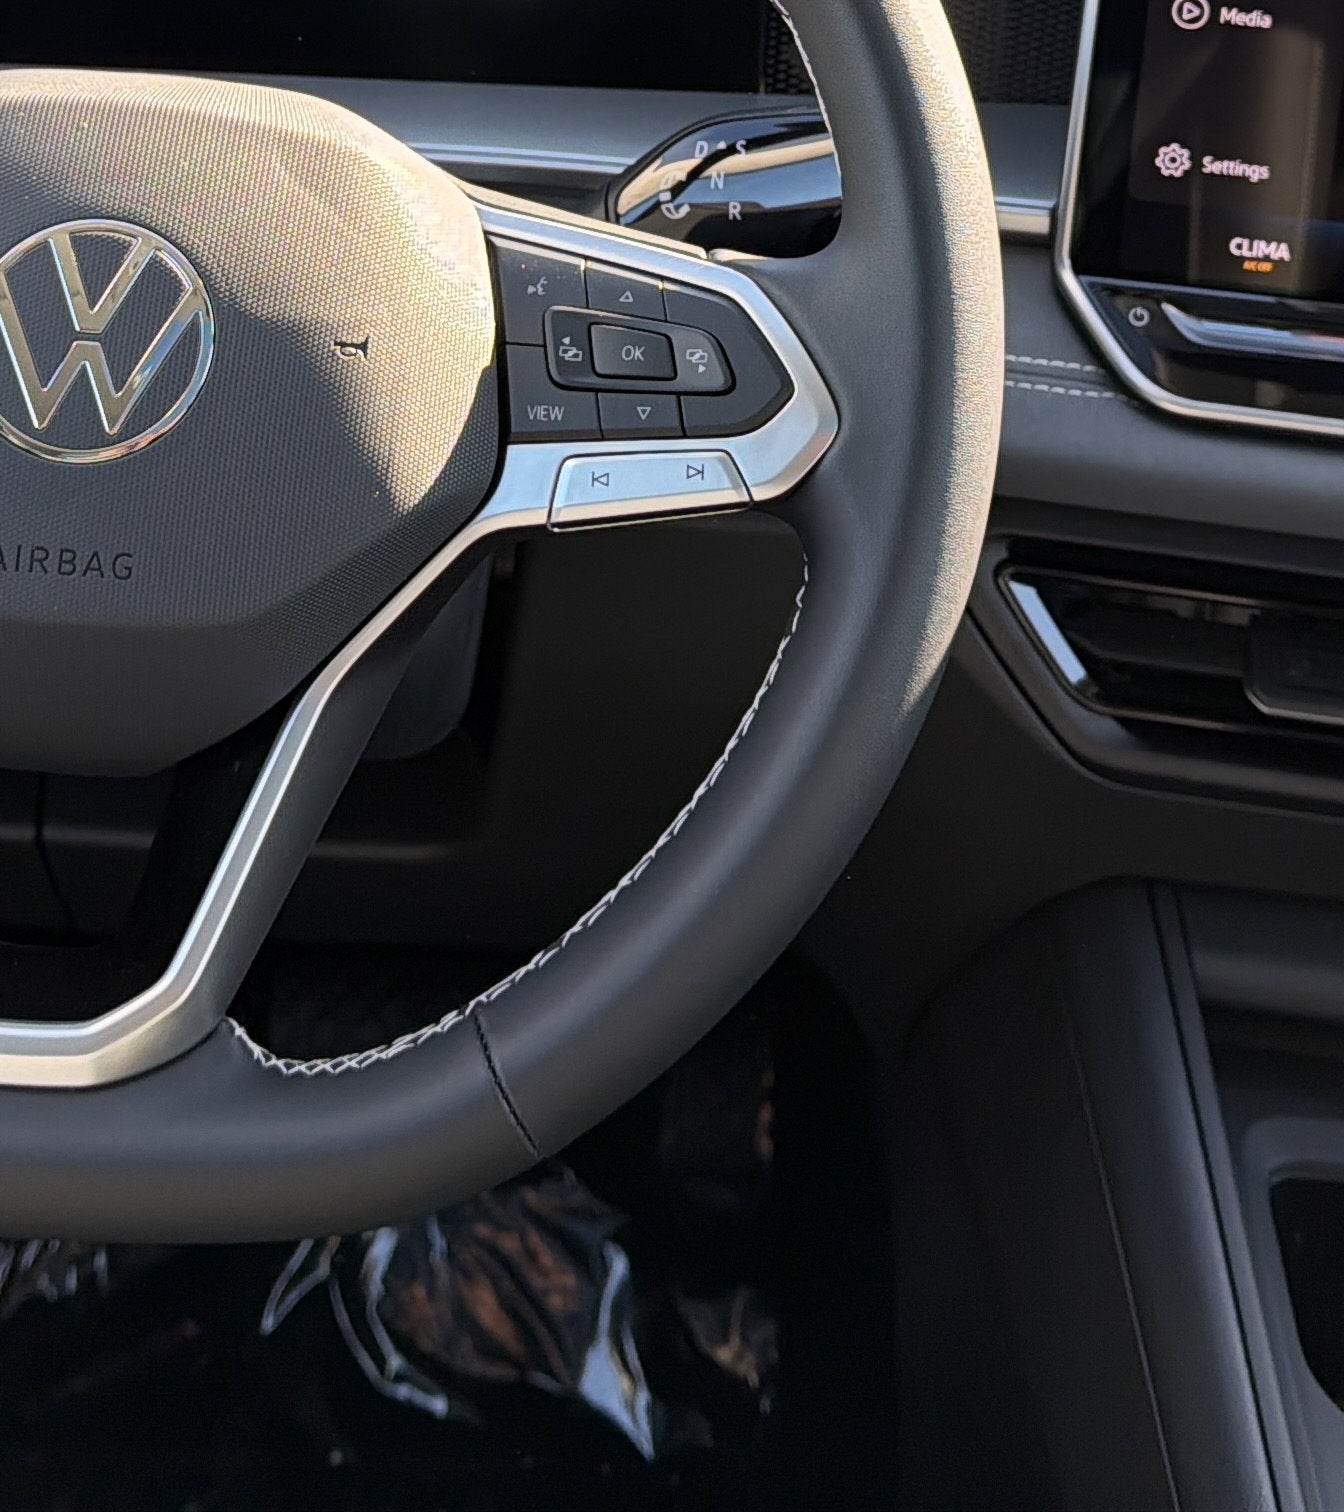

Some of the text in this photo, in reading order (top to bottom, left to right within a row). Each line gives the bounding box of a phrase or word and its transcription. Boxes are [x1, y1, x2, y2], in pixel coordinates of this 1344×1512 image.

[1220, 7, 1272, 29] Media
[694, 139, 747, 159] D S
[1202, 156, 1270, 182] Settings
[710, 171, 725, 189] N
[728, 201, 742, 221] R
[1229, 237, 1291, 262] CLIMA
[621, 344, 645, 361] OK
[527, 405, 565, 422] VIEW
